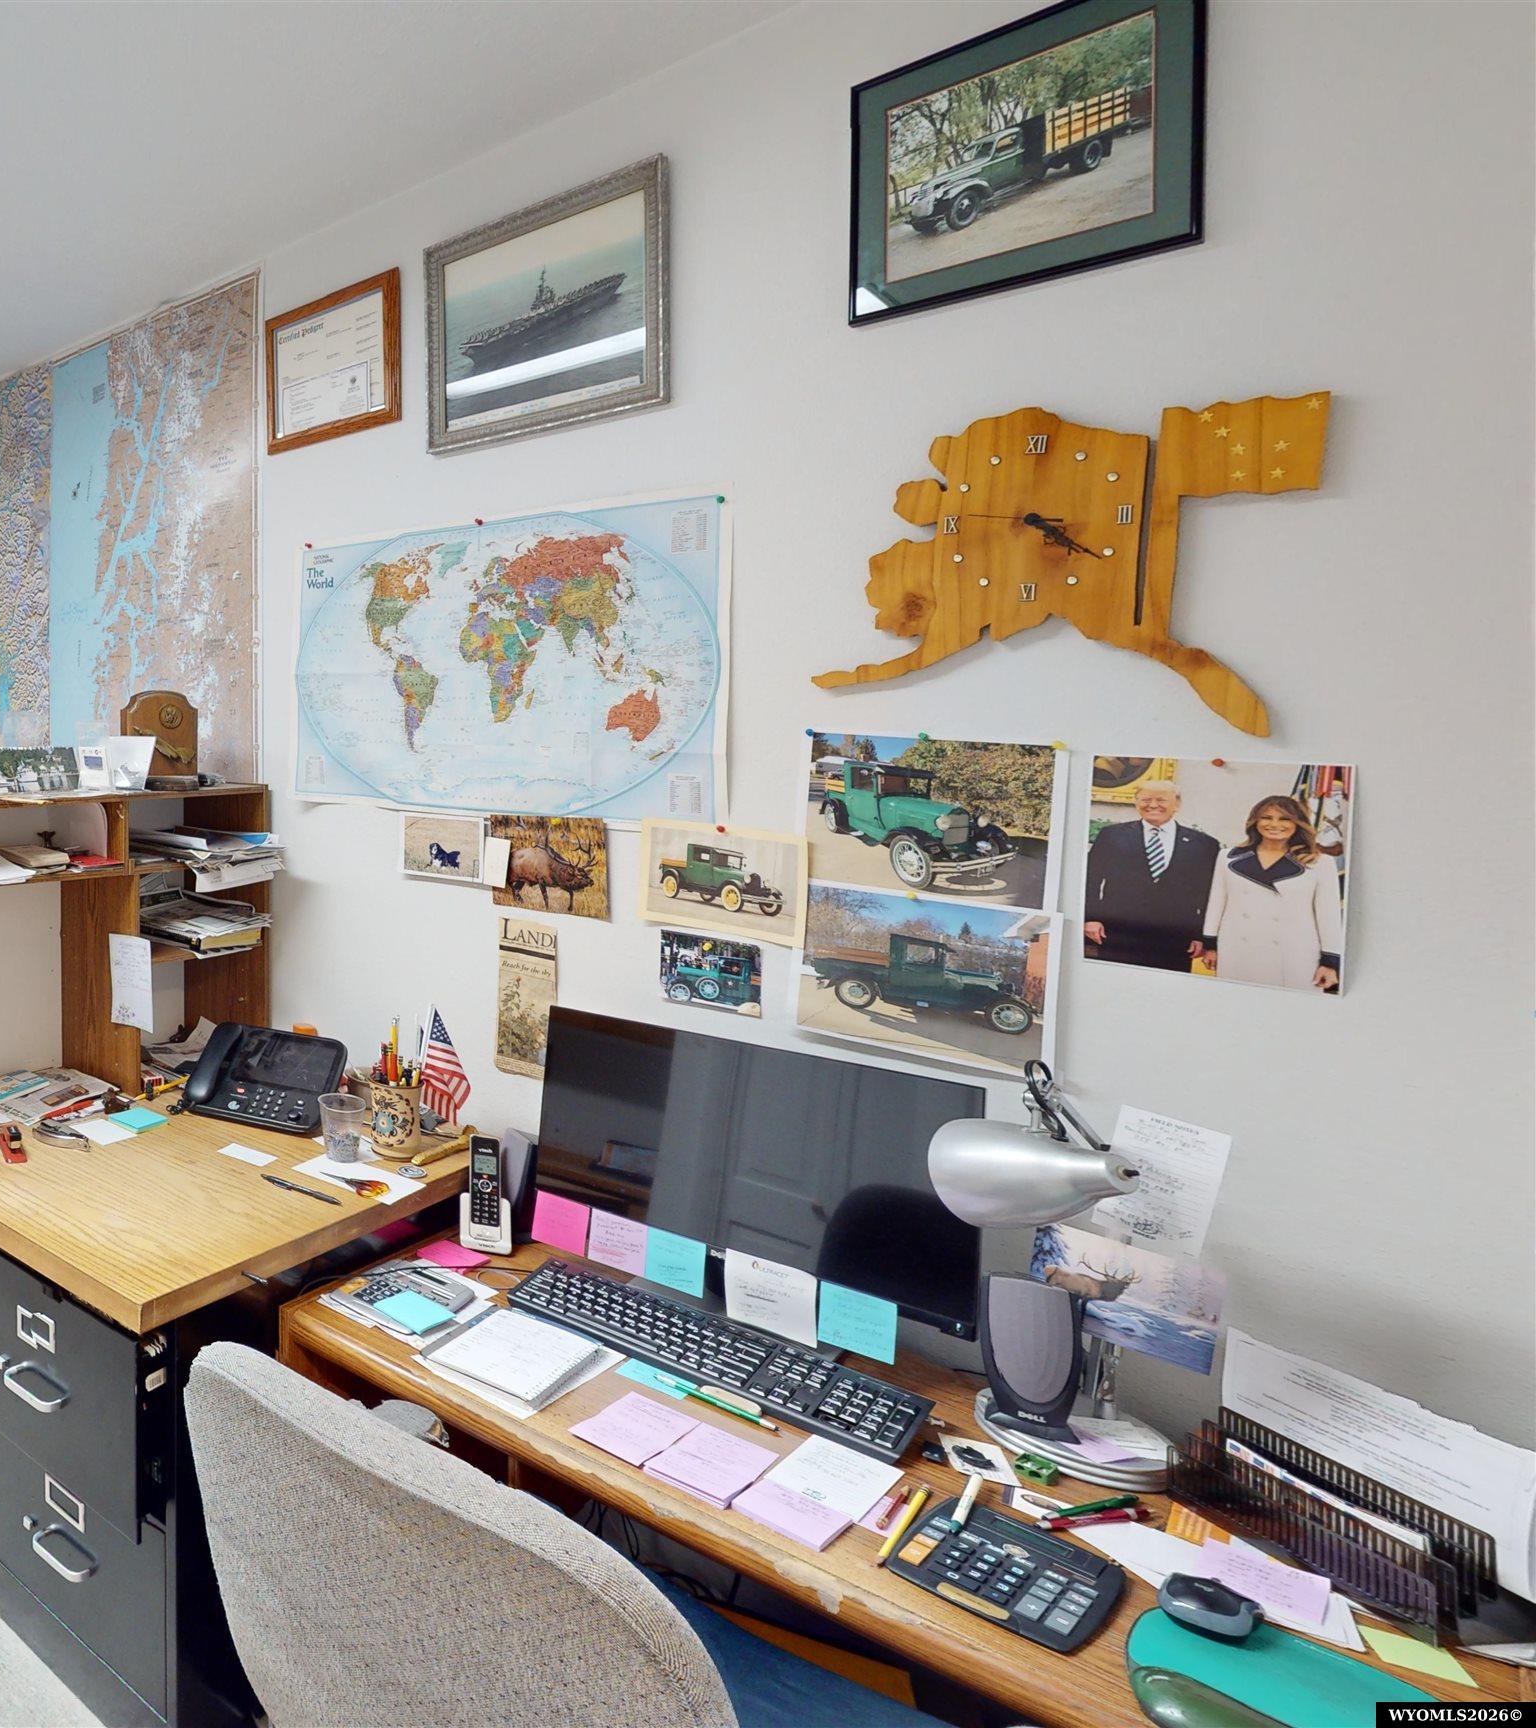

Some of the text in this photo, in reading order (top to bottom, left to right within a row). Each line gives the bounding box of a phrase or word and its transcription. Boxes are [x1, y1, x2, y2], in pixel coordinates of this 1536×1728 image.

[1025, 435, 1048, 455] XII
[1117, 504, 1134, 525] III
[943, 516, 959, 535] IX
[306, 567, 324, 578] The
[307, 577, 334, 589] World
[1018, 583, 1037, 602] VI
[502, 917, 557, 949] LAND
[1017, 1410, 1047, 1423] DELL
